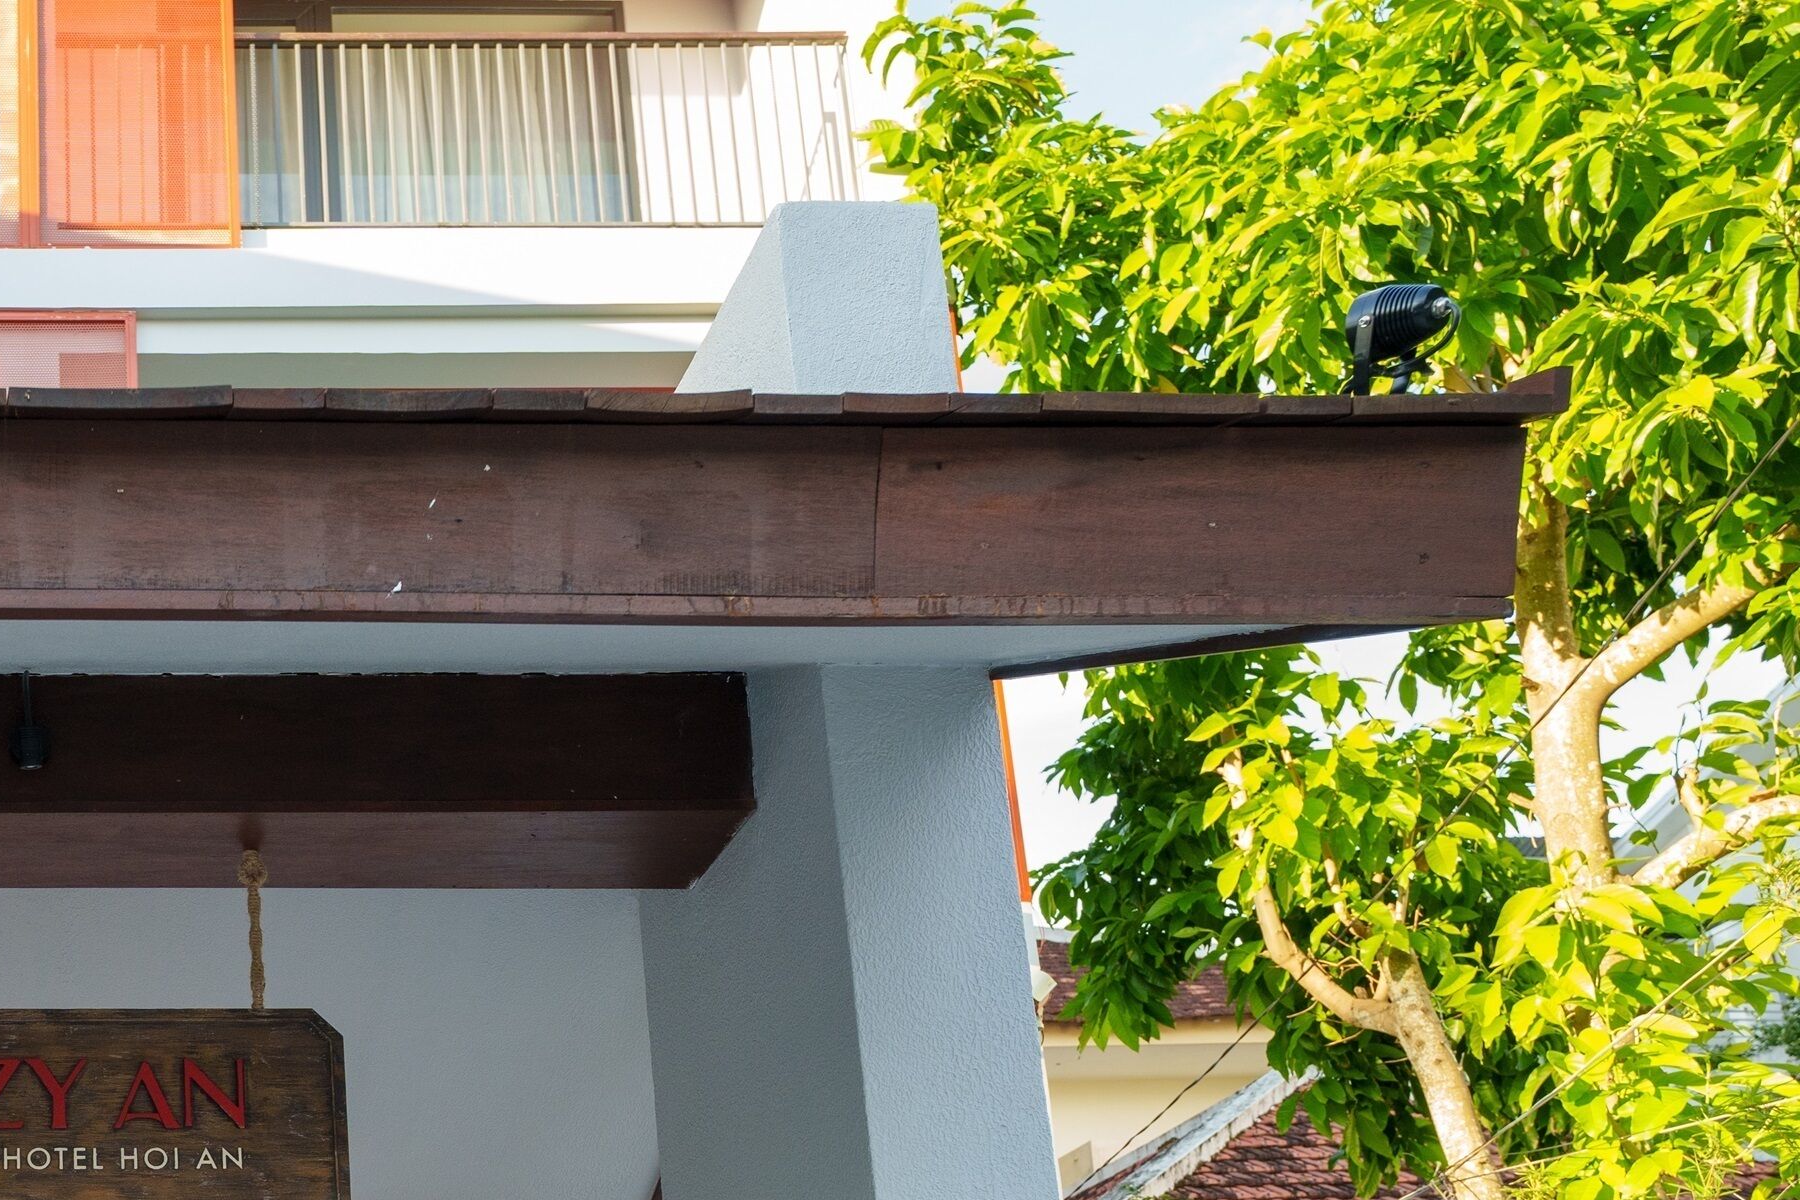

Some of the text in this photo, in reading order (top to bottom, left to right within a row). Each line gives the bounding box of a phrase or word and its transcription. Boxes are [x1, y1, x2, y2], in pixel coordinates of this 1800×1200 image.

[114, 1058, 246, 1130] AN
[3, 1147, 105, 1171] HOTEL
[120, 1147, 180, 1171] HOI
[196, 1147, 244, 1171] AN
